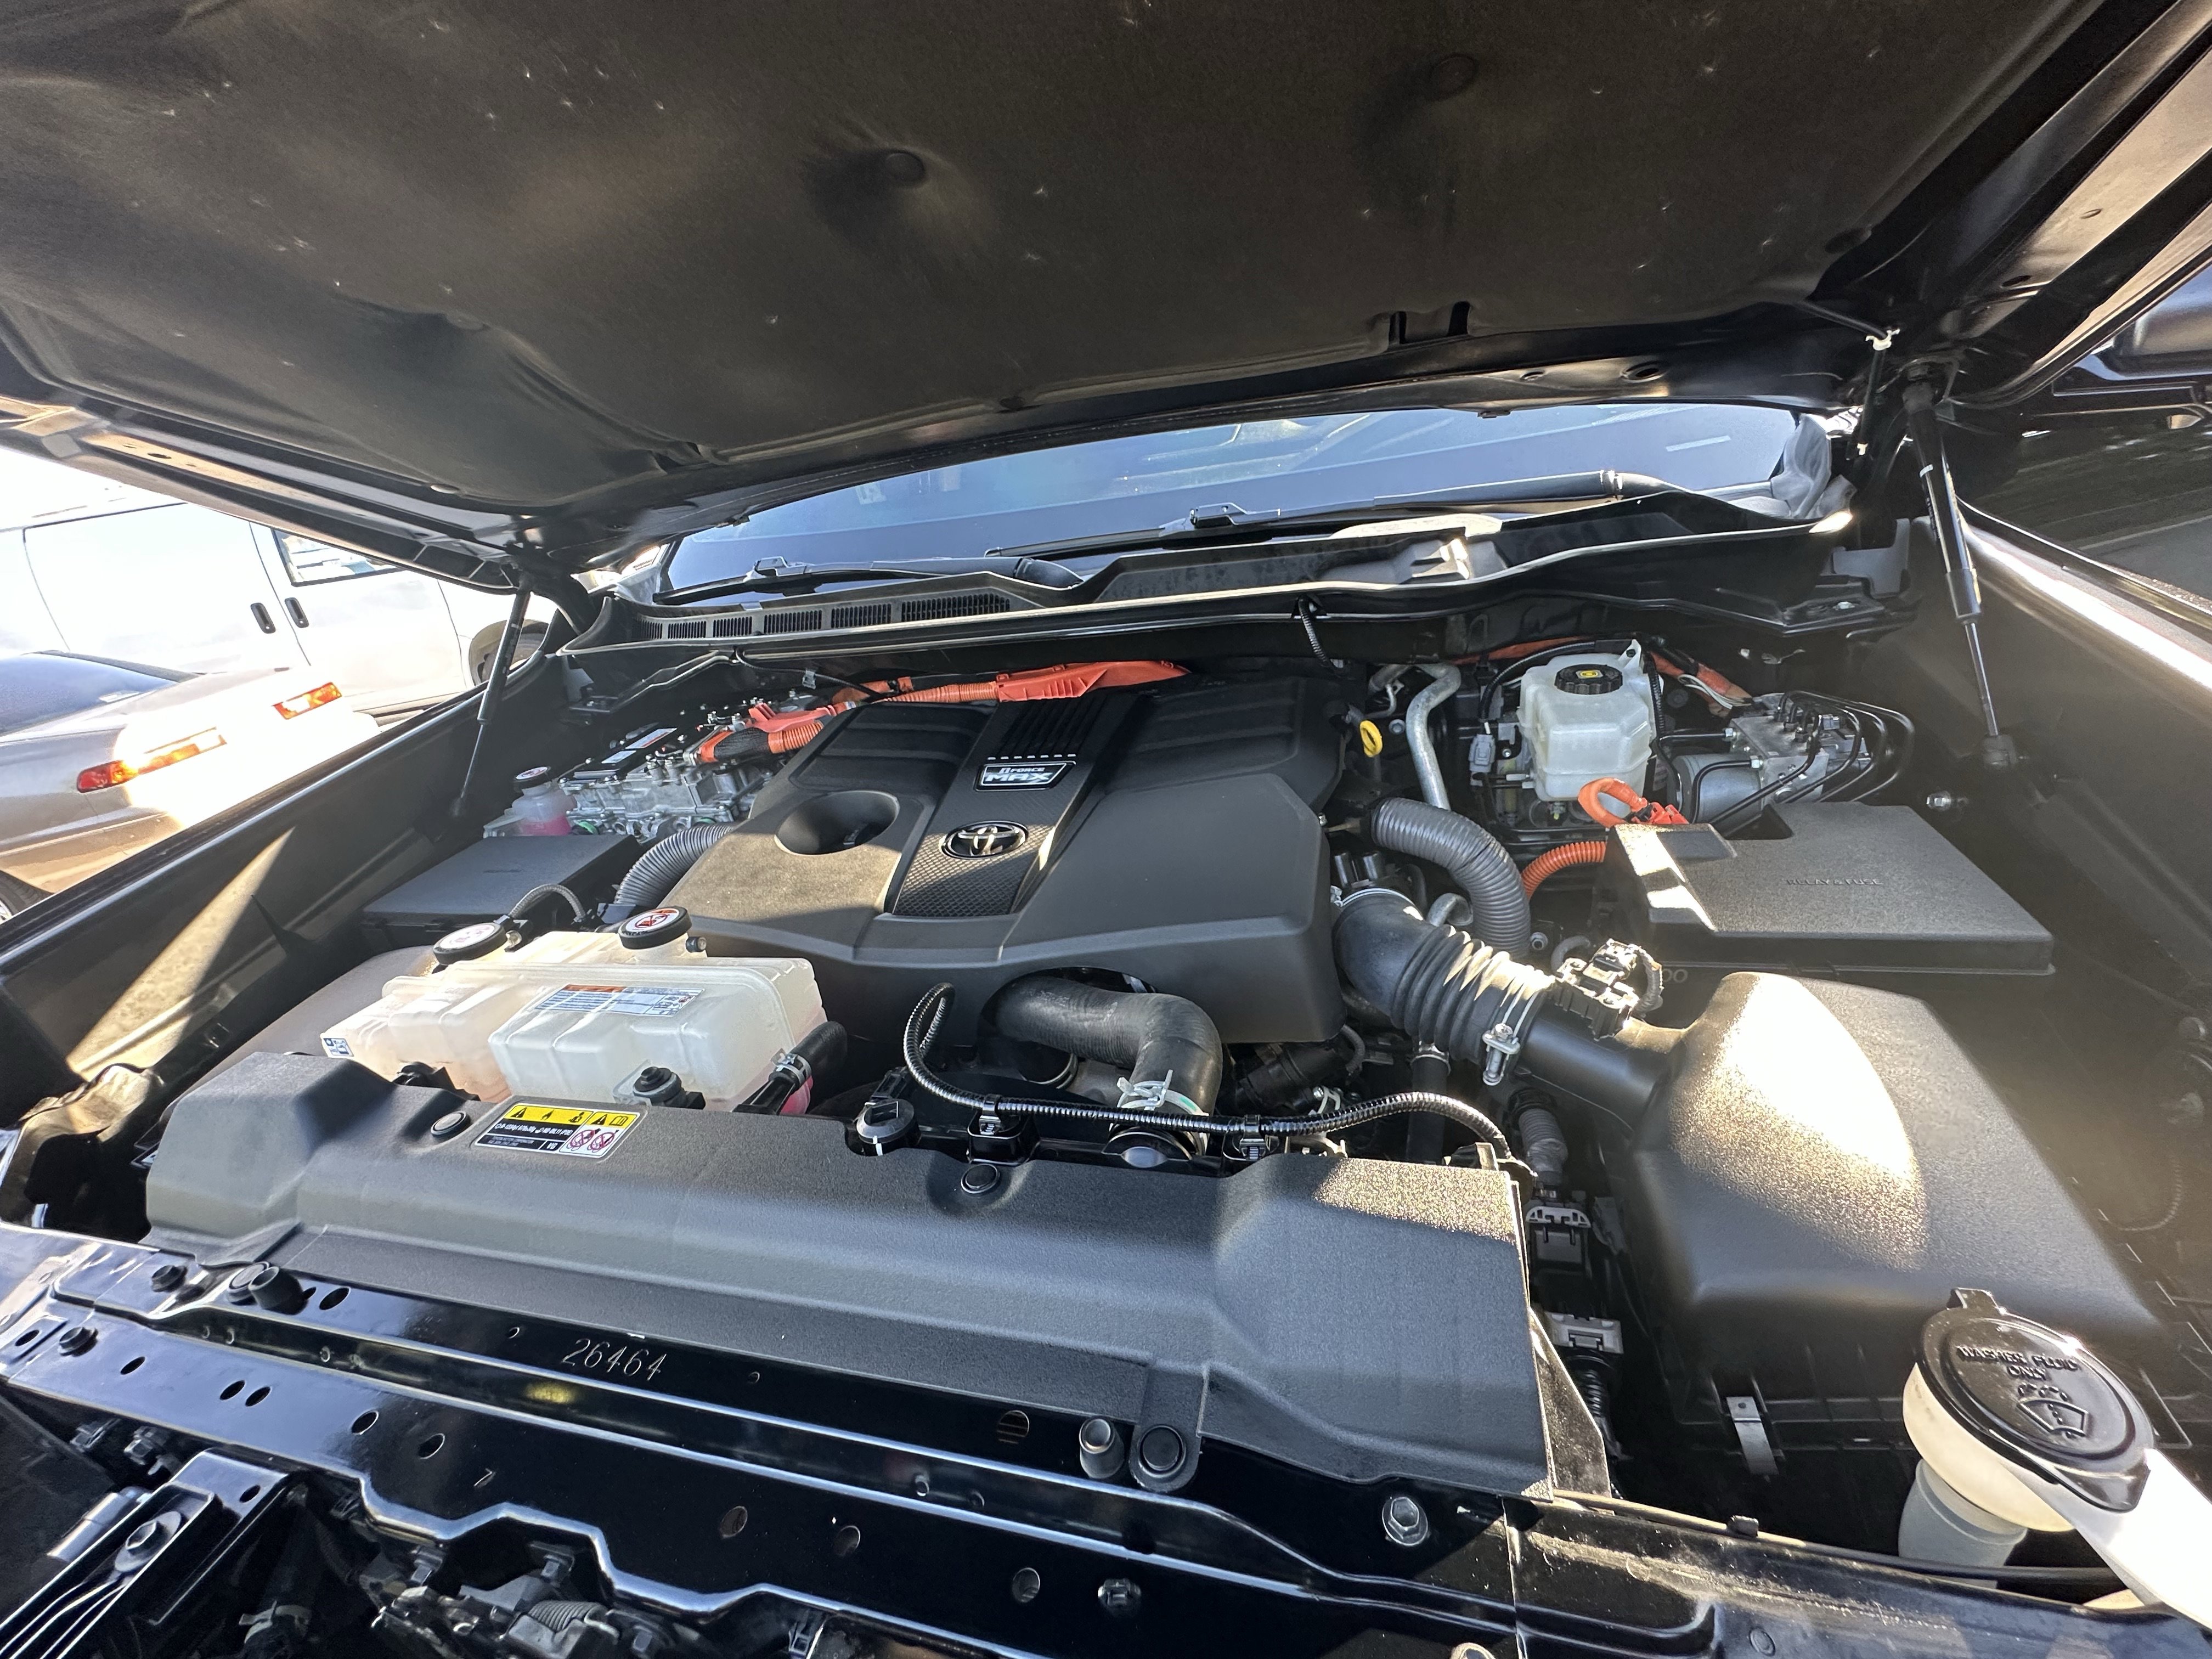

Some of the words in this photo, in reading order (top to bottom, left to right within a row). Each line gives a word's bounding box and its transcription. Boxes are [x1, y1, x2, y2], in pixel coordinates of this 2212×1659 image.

[985, 772, 1053, 781] MAX
[561, 1338, 667, 1381] 26464
[1956, 1346, 2027, 1365] WASHER
[2032, 1354, 2080, 1372] FLUID
[2007, 1365, 2047, 1381] ONLY
